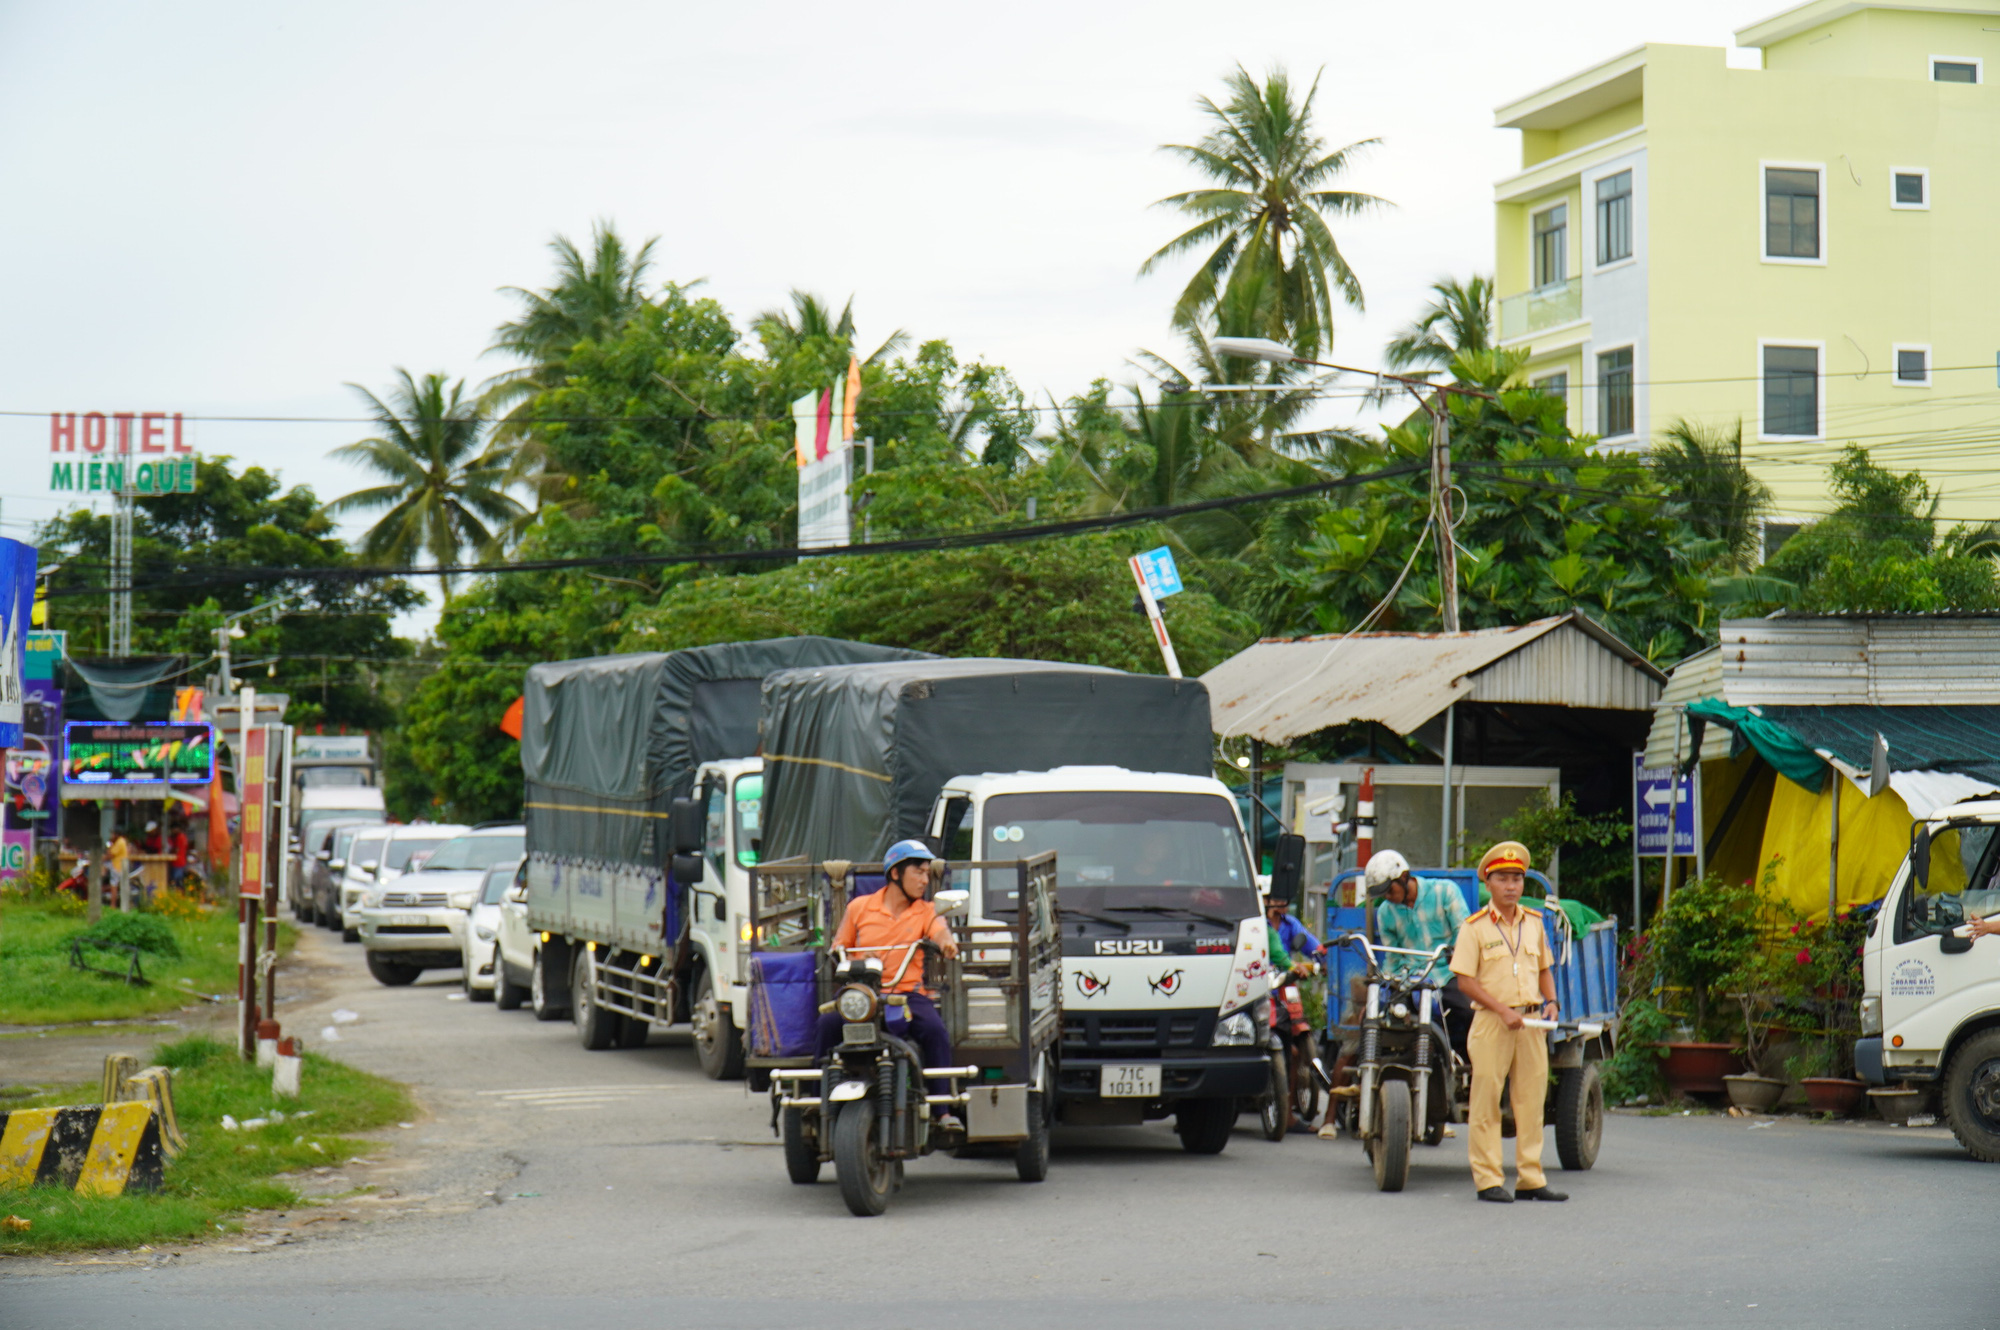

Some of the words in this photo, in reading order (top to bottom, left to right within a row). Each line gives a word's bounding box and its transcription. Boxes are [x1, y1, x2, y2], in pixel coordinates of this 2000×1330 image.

[51, 412, 193, 453] HOTEL
[136, 454, 194, 494] QUÊ
[1095, 940, 1164, 955] ISUZU
[1119, 1067, 1144, 1080] 71C
[1109, 1081, 1153, 1095] 103.11
